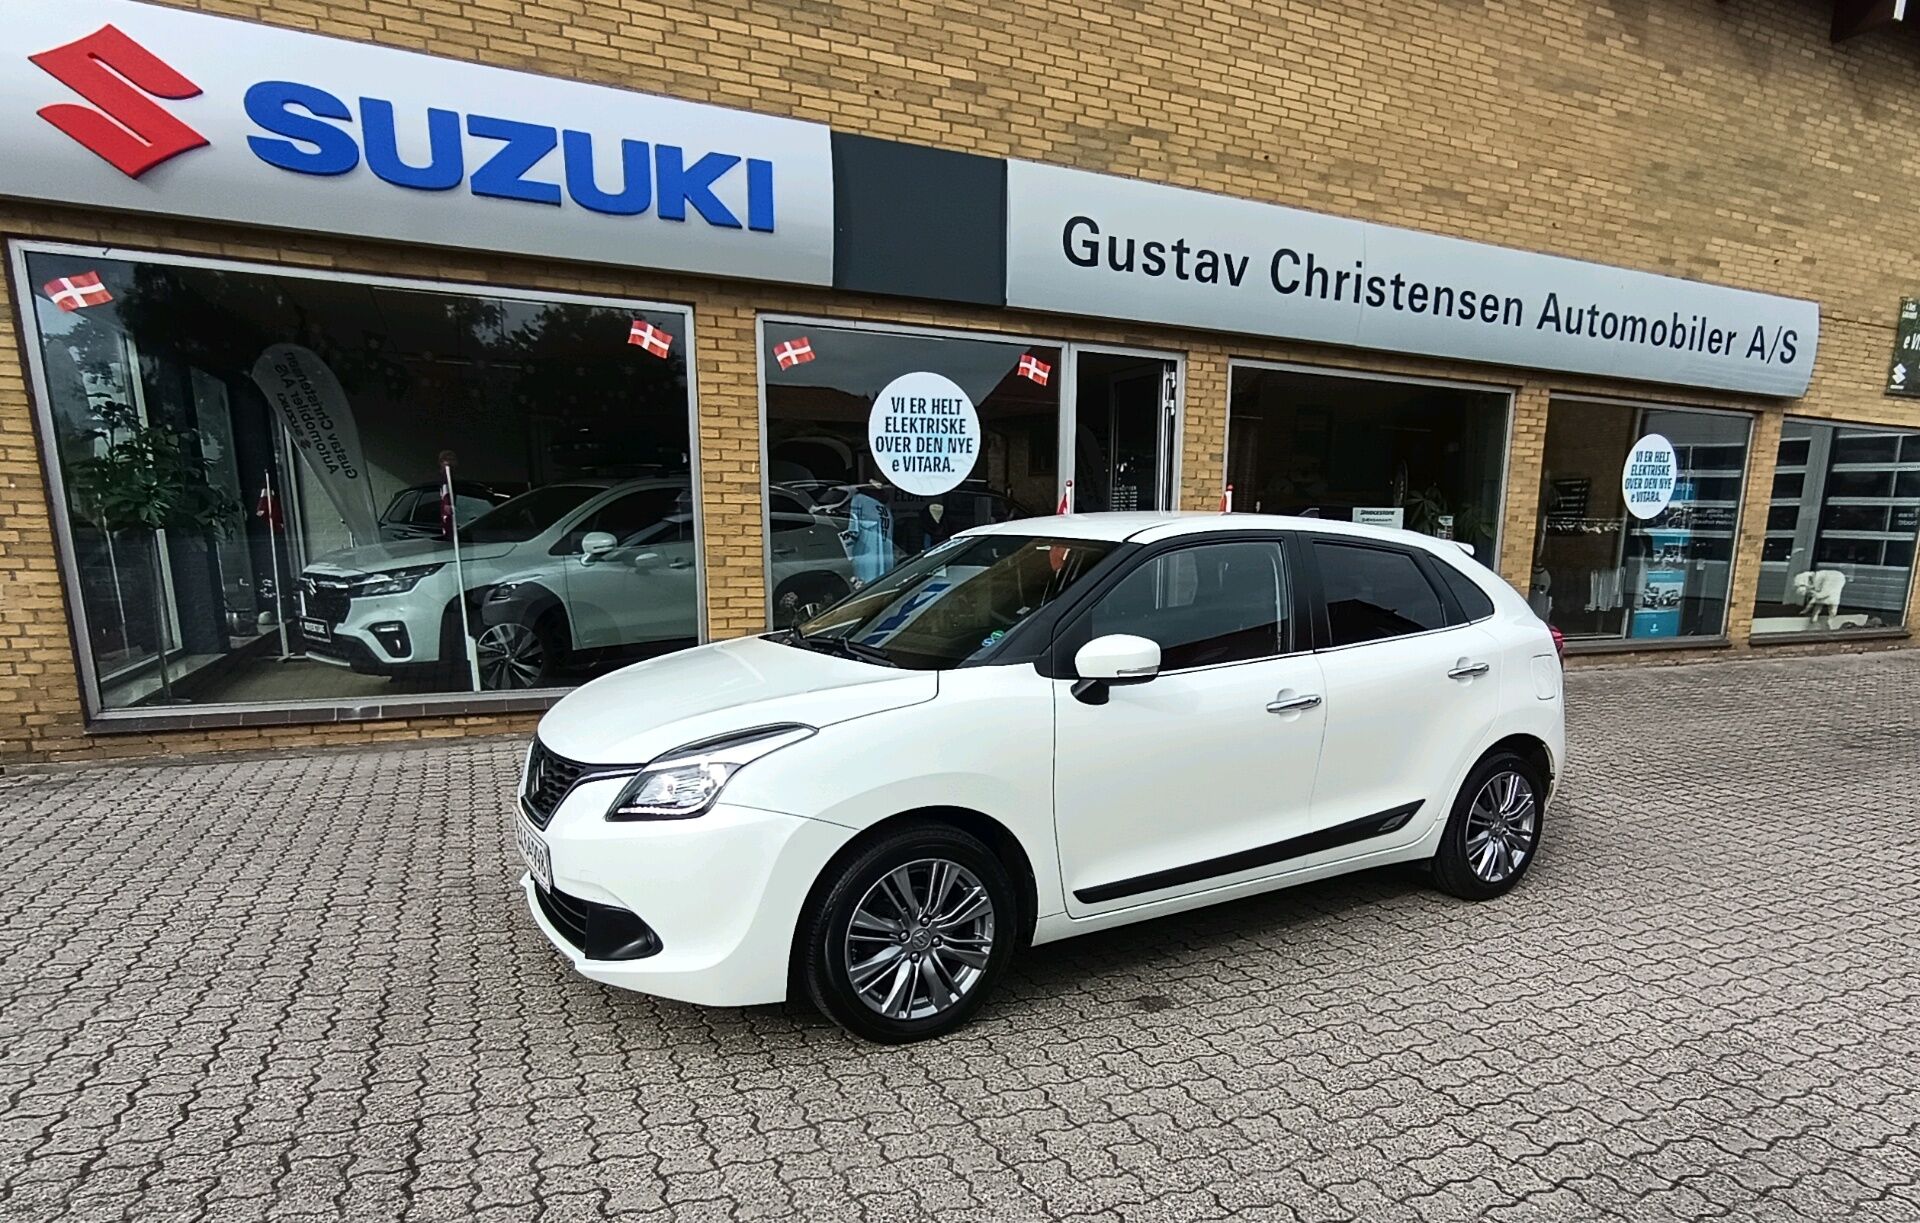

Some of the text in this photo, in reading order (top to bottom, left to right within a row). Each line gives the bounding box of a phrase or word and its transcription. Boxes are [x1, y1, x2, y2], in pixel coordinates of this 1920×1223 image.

[243, 80, 774, 233] SUZUKI
[1062, 215, 1798, 365] Gustav Christensen Automobiler A/S
[891, 397, 963, 415] VI ER HELT
[885, 416, 967, 434] ELEKTRISKE
[875, 436, 973, 454] OVER DEN NYE
[892, 455, 955, 473] e VITARA.
[1636, 451, 1671, 462] VI ER HELT
[1631, 464, 1671, 476] ELEKTRISKE
[1625, 478, 1643, 490] OVER
[1644, 478, 1657, 489] DEN
[1657, 478, 1672, 489] NYE
